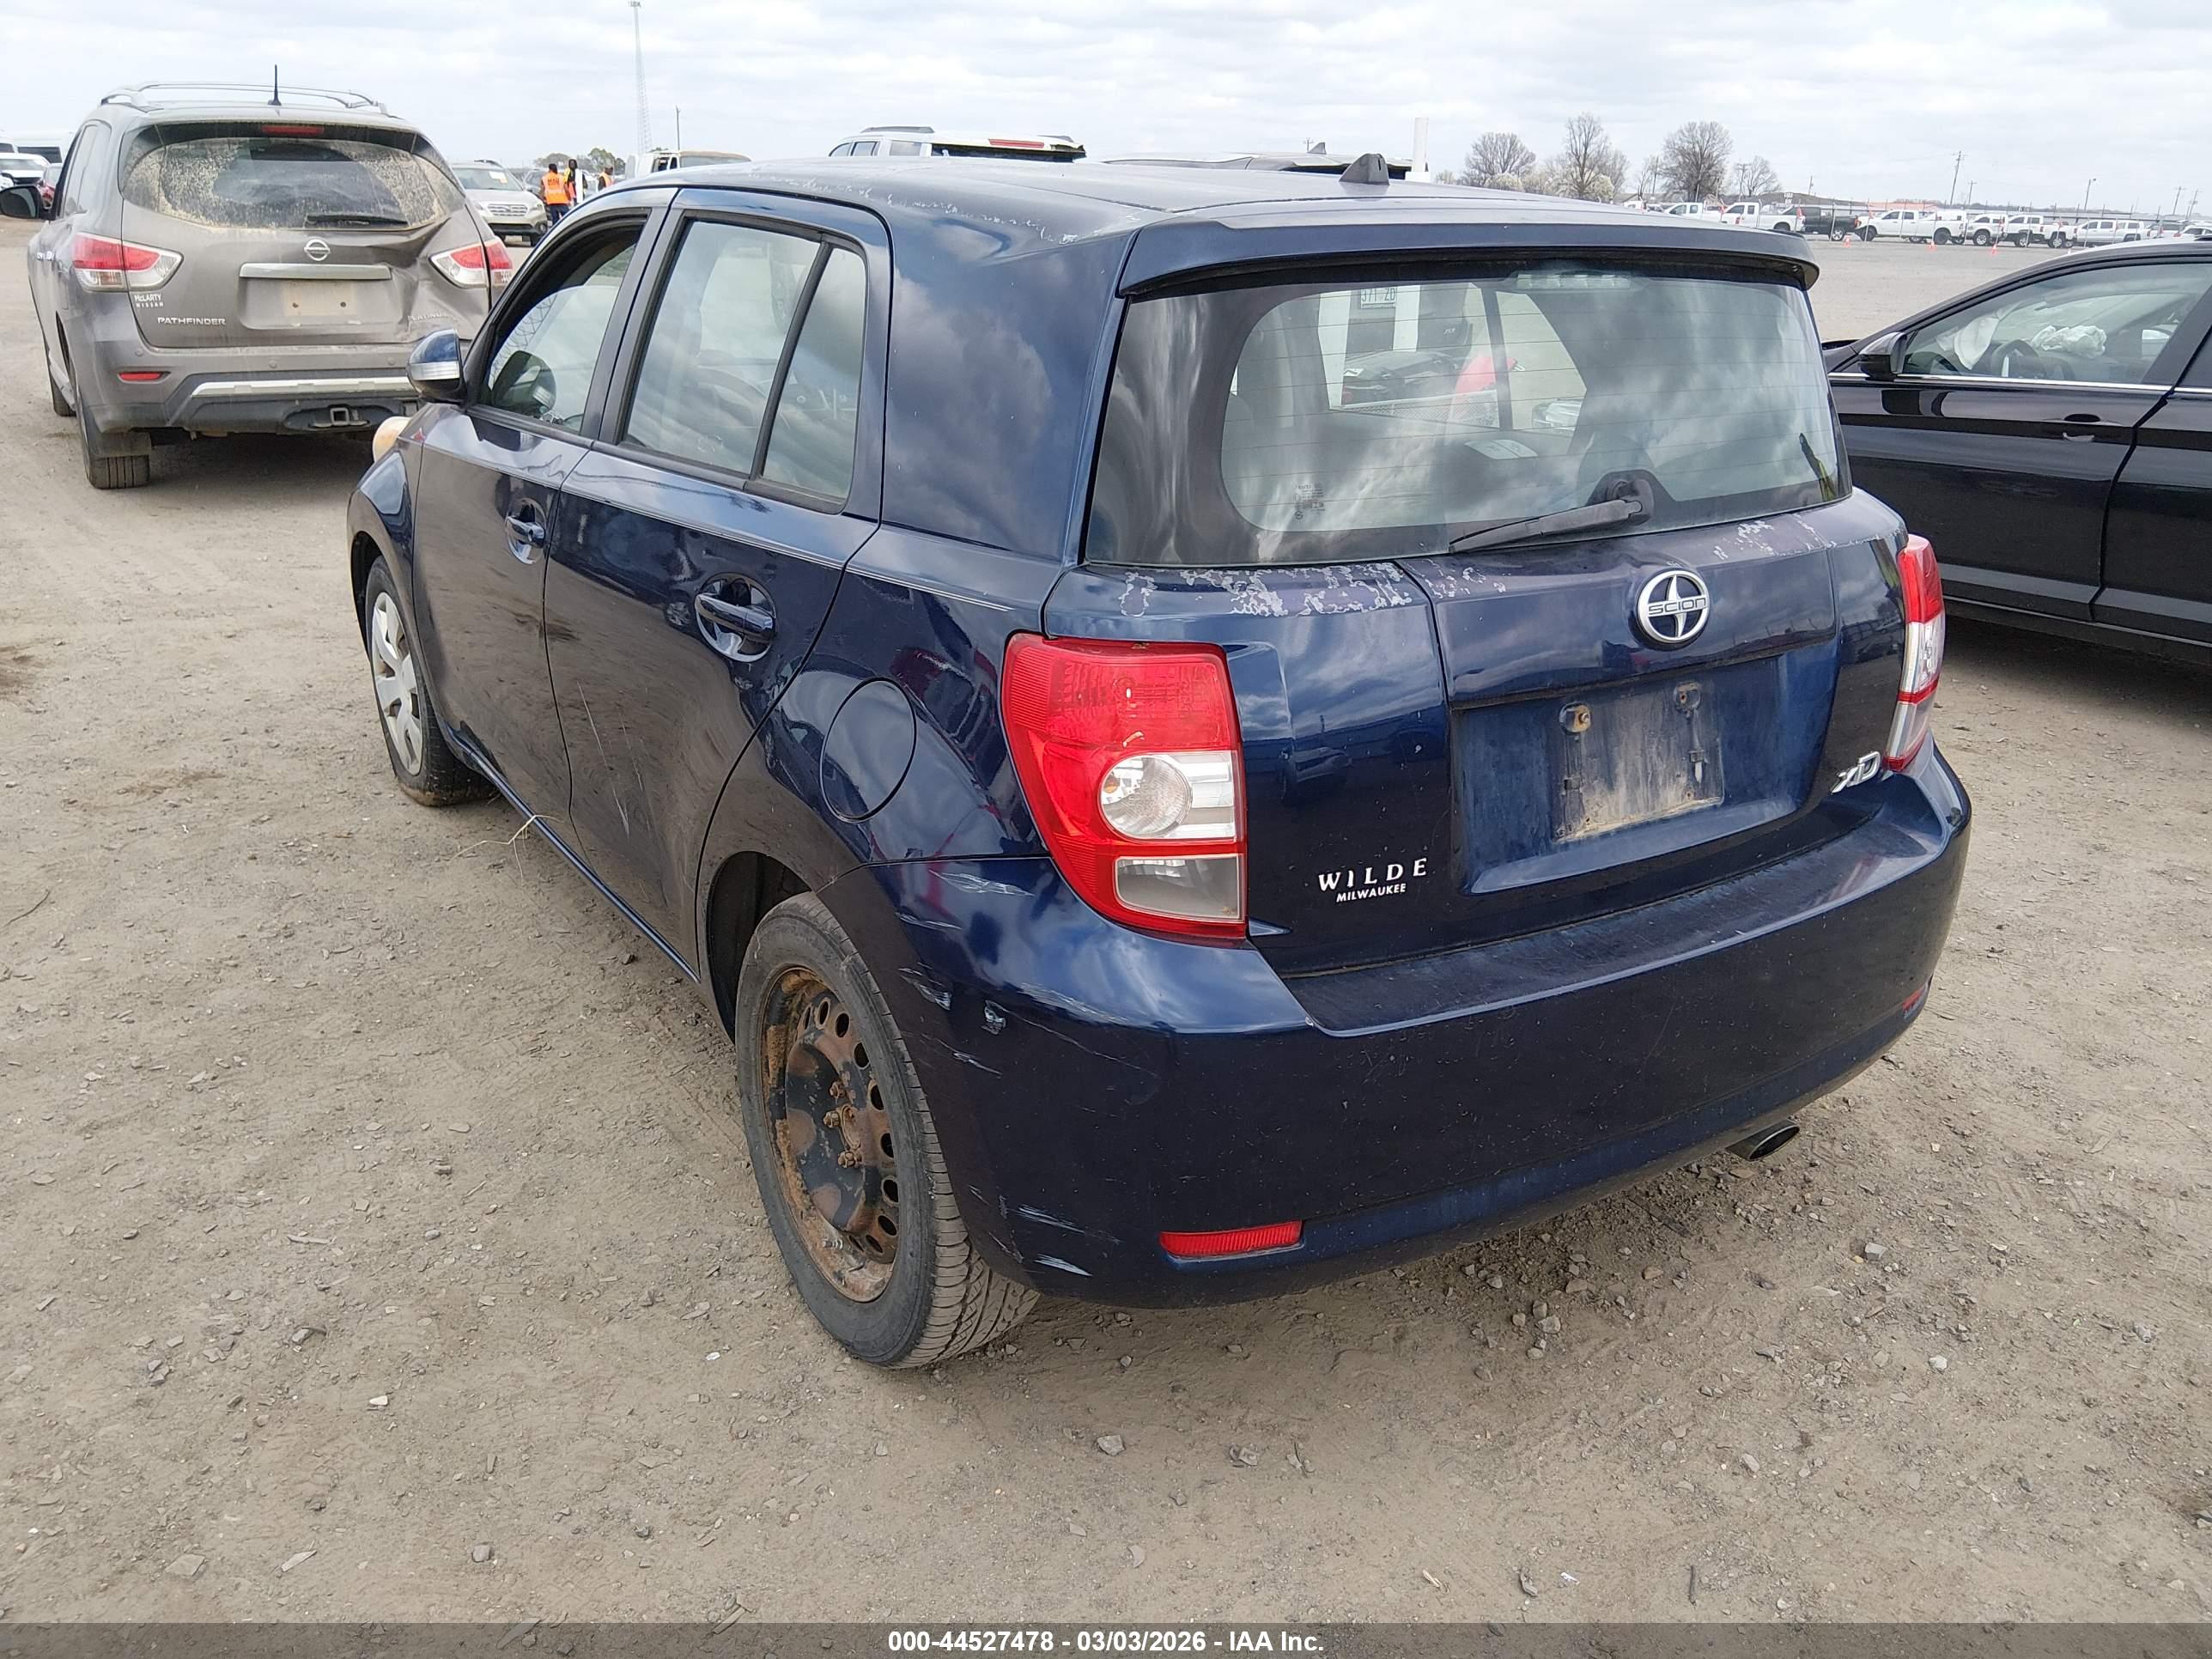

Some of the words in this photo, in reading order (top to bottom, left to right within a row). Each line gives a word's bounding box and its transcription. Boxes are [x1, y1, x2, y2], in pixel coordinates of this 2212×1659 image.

[157, 317, 227, 325] PATHFINDER
[1649, 597, 1706, 615] SCION
[1830, 750, 1881, 793] xD
[1318, 858, 1427, 891] WILDE
[1336, 883, 1407, 902] MILWAUKEE
